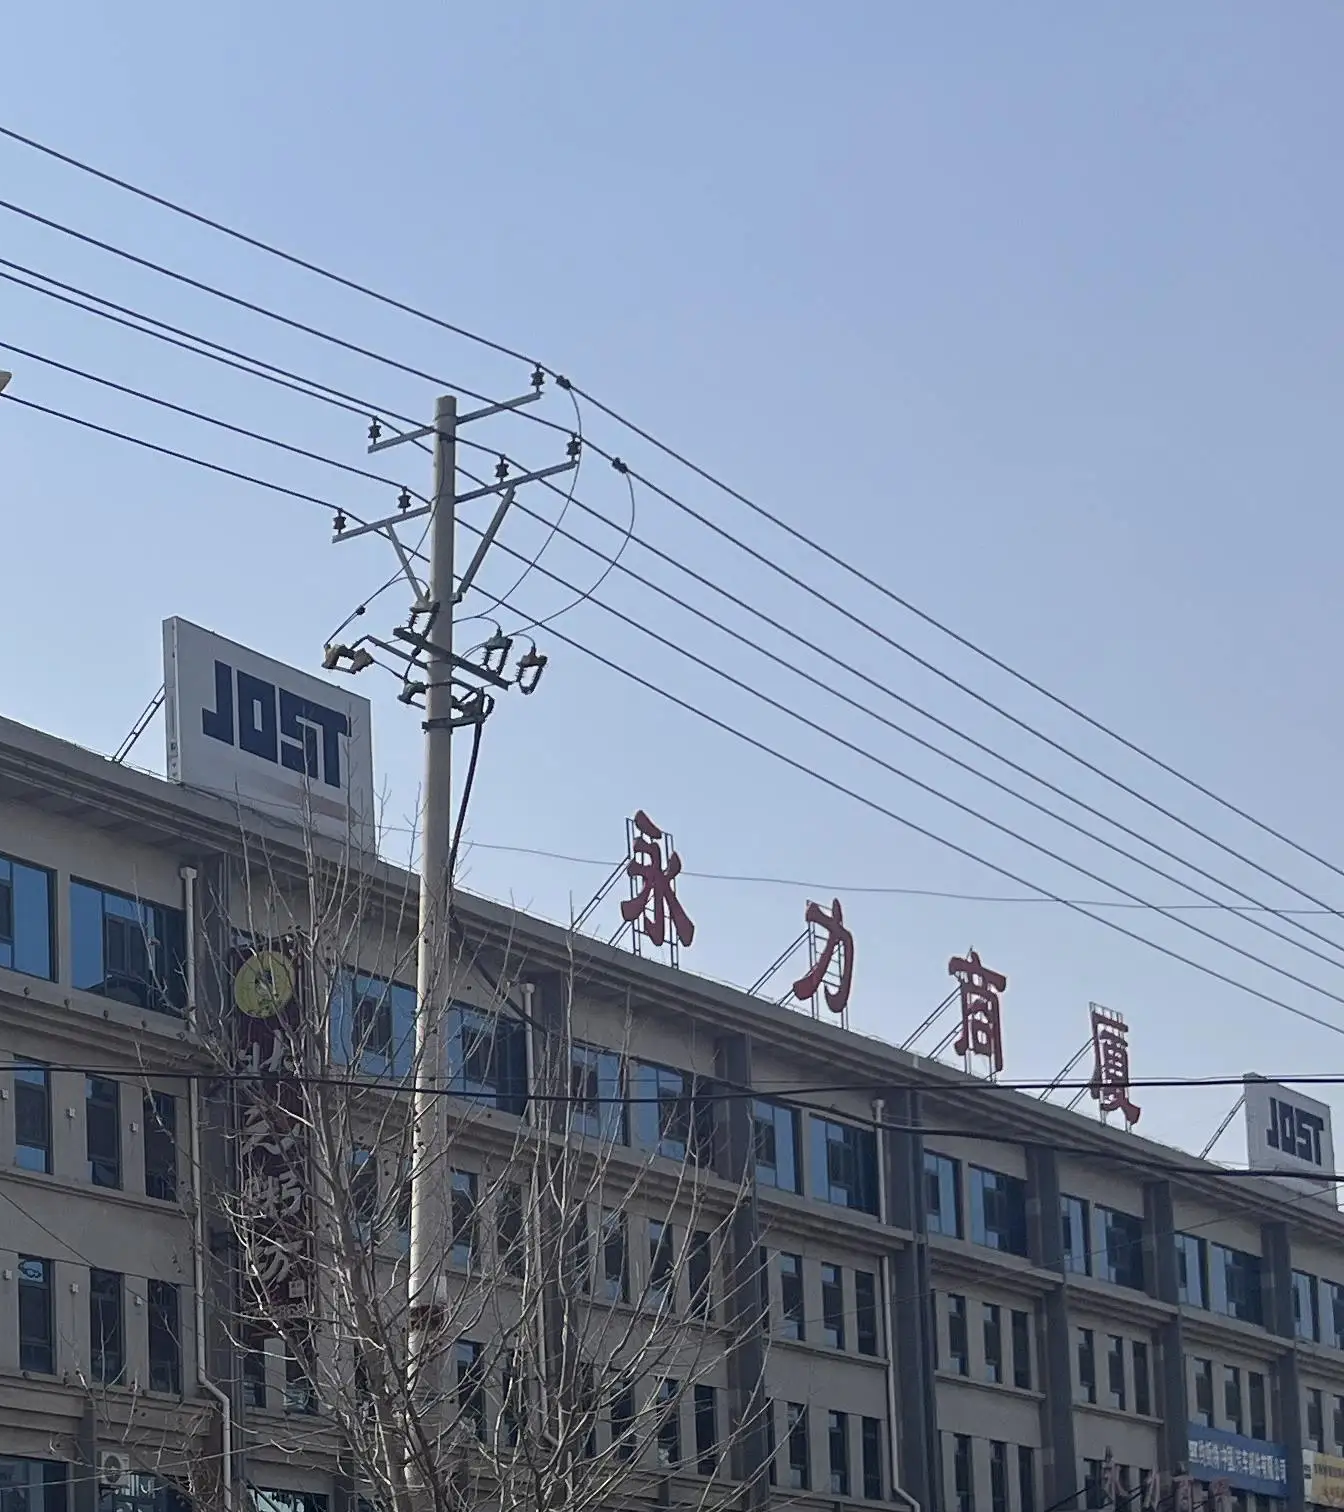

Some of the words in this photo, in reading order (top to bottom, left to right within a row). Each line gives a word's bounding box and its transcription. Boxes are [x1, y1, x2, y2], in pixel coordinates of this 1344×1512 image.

[201, 659, 352, 789] JOST
[621, 810, 1141, 1127] 永力商厦
[1266, 1096, 1325, 1167] JOST
